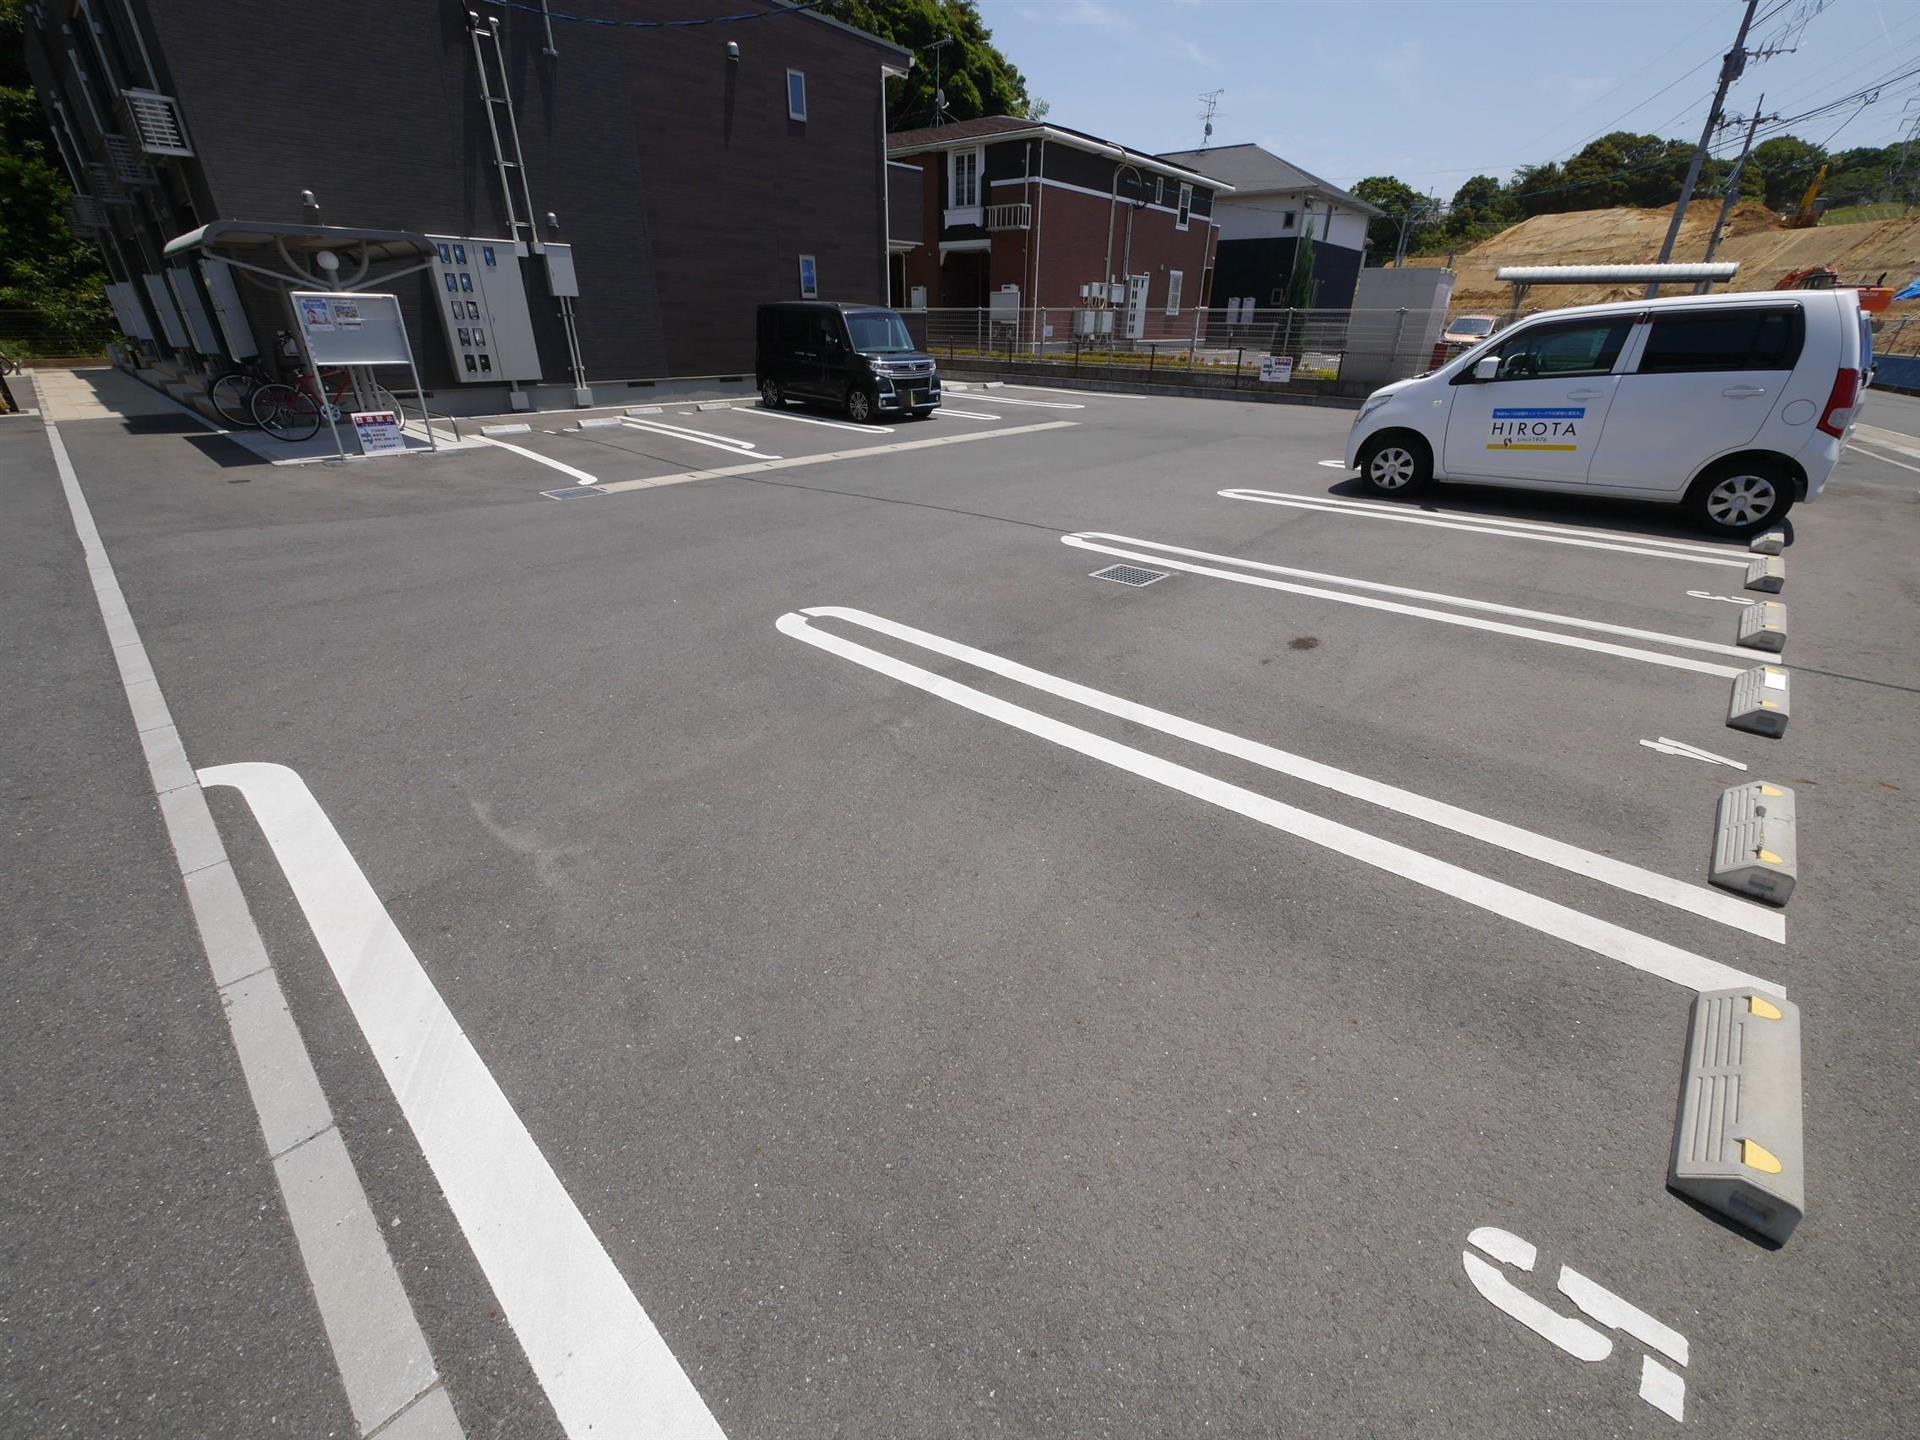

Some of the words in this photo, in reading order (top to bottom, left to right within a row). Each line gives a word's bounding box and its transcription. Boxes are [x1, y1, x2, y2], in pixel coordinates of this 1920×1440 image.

[1491, 422, 1576, 436] HIROTA
[1639, 736, 1748, 771] 4
[1463, 1227, 1689, 1422] 5
